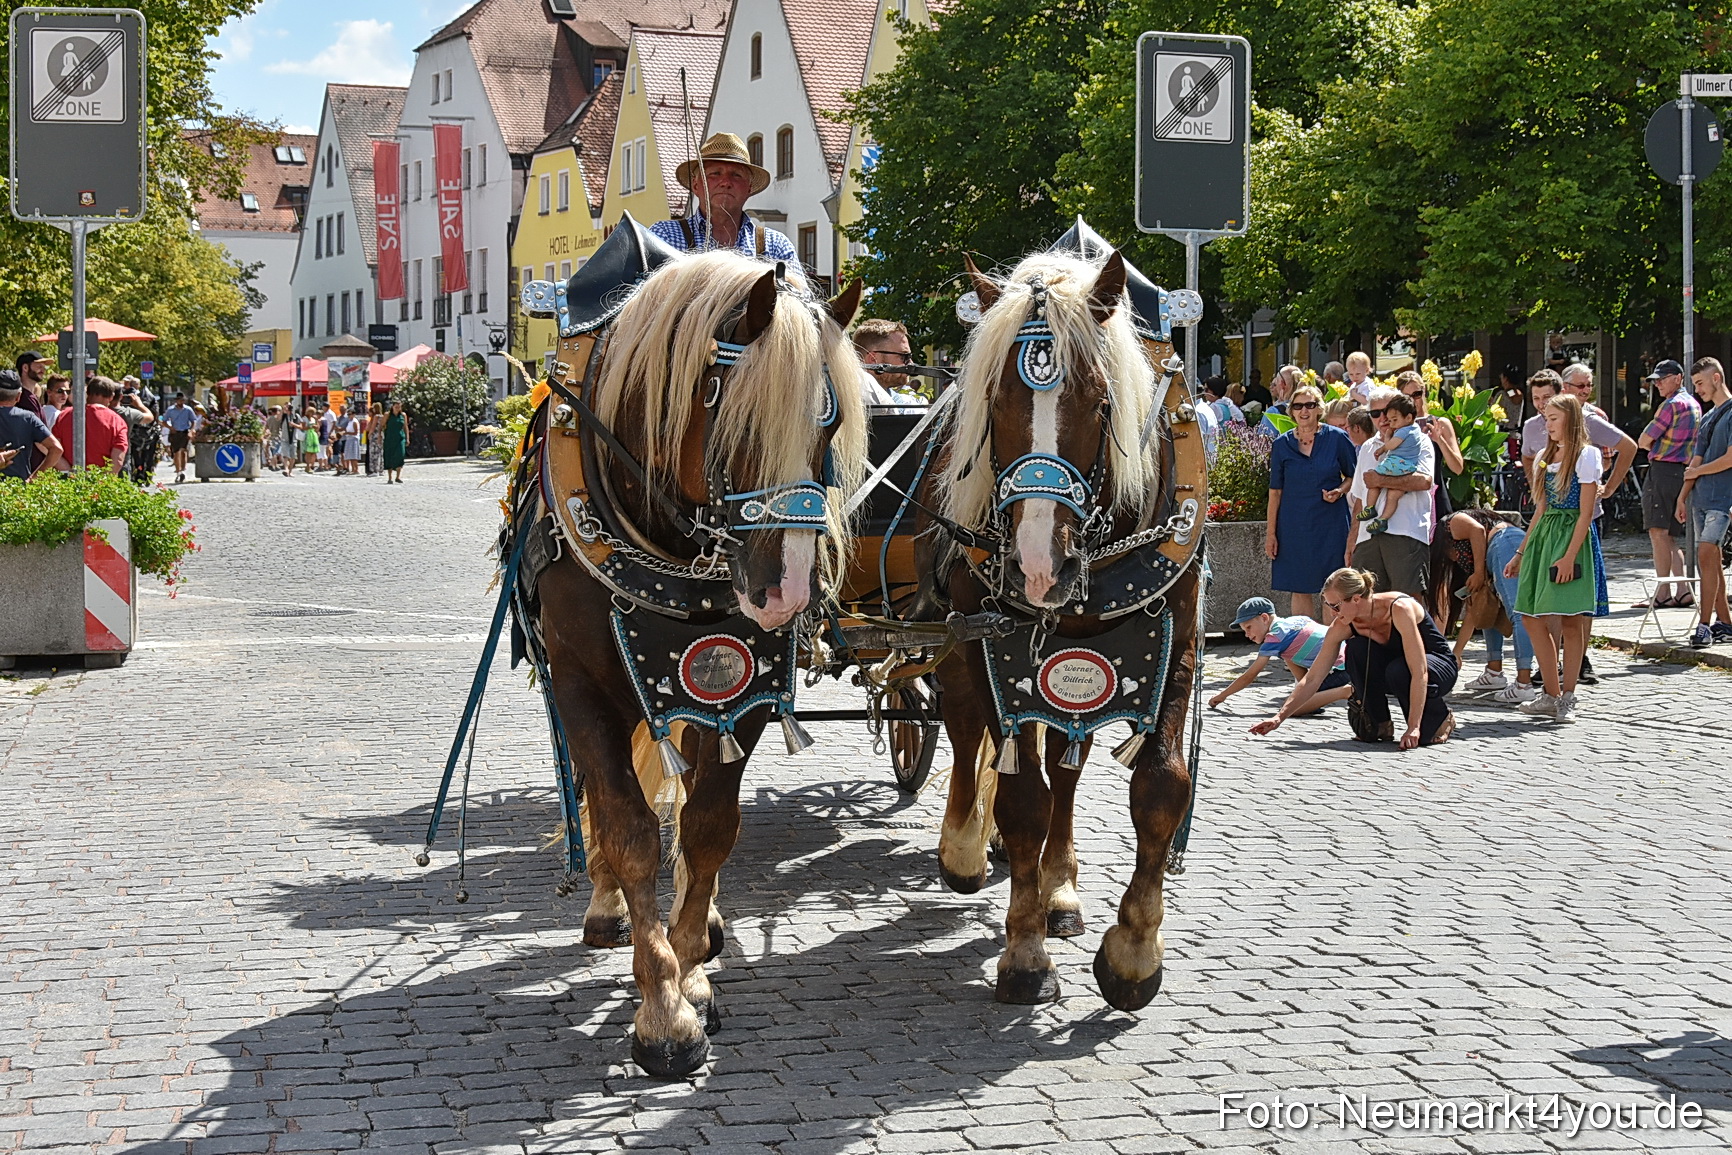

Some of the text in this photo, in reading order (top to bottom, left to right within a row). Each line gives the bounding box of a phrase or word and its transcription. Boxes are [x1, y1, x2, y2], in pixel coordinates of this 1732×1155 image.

[1696, 78, 1726, 92] Ulmer
[55, 101, 101, 116] ZONE
[1174, 121, 1213, 136] ZONE
[376, 193, 398, 251] SALE
[549, 236, 570, 256] HOTEL
[702, 652, 732, 661] Werner
[1062, 664, 1095, 673] Werner
[1057, 686, 1096, 699] Dietersdorf
